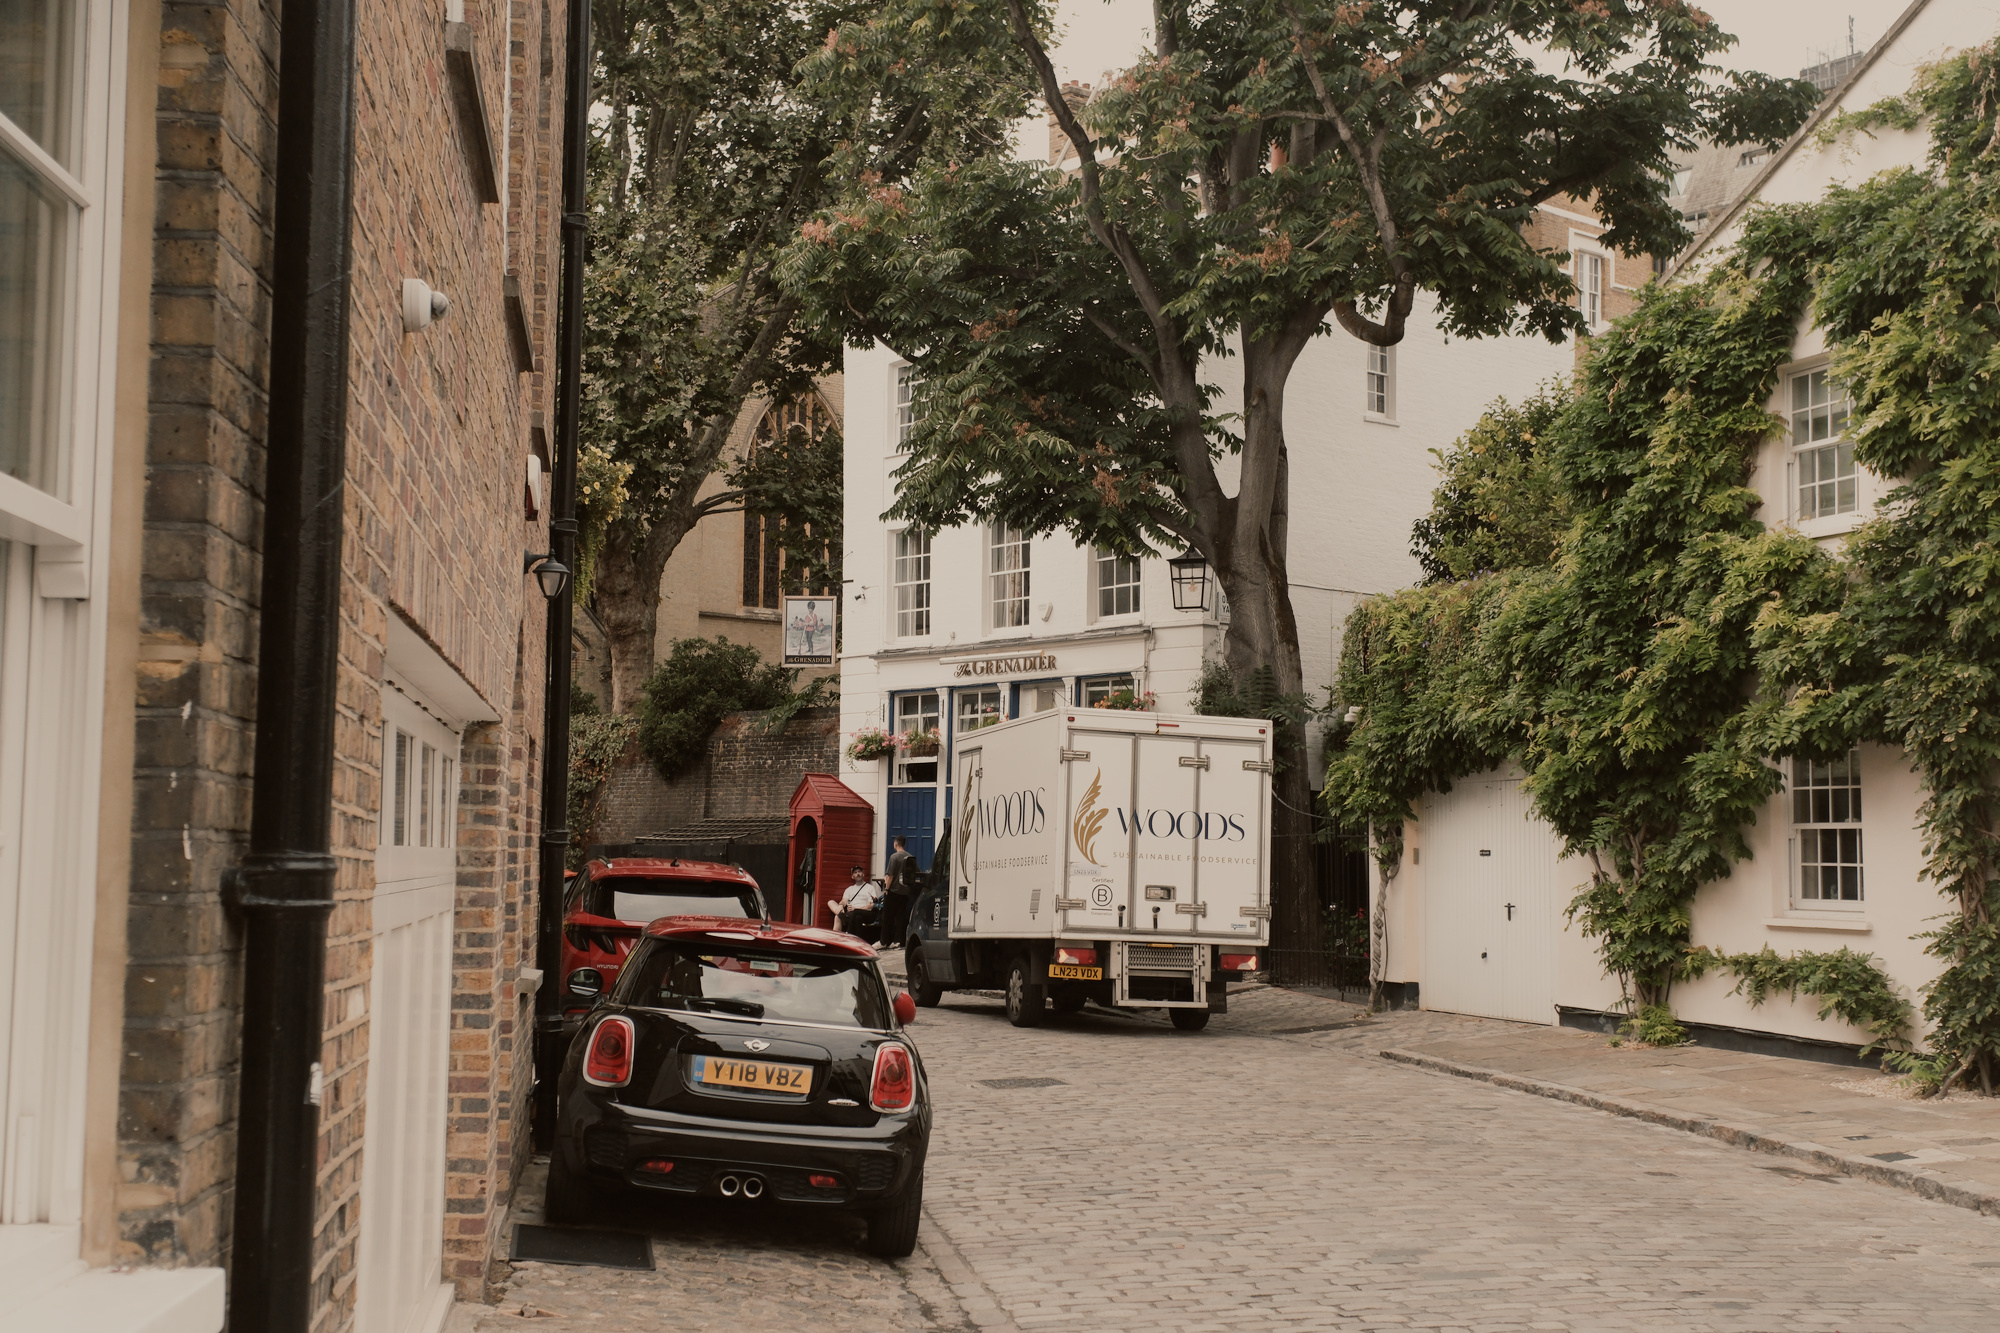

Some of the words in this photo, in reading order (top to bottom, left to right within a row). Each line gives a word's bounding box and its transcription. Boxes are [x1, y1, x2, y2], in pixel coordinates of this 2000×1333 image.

[954, 662, 972, 677] The
[972, 655, 1057, 676] GRENADIER
[978, 787, 1046, 839] WOODS
[1117, 807, 1245, 842] WOODS
[973, 858, 1008, 871] SUSTAINABLE
[1009, 854, 1048, 868] FOODSERVICE
[1112, 851, 1182, 862] SUSTAINABLE
[1186, 854, 1257, 865] FOODSERVICE
[1053, 966, 1078, 977] LN23
[1081, 968, 1099, 979] VDX
[713, 1060, 758, 1083] YT18
[764, 1066, 804, 1088] VBZ
